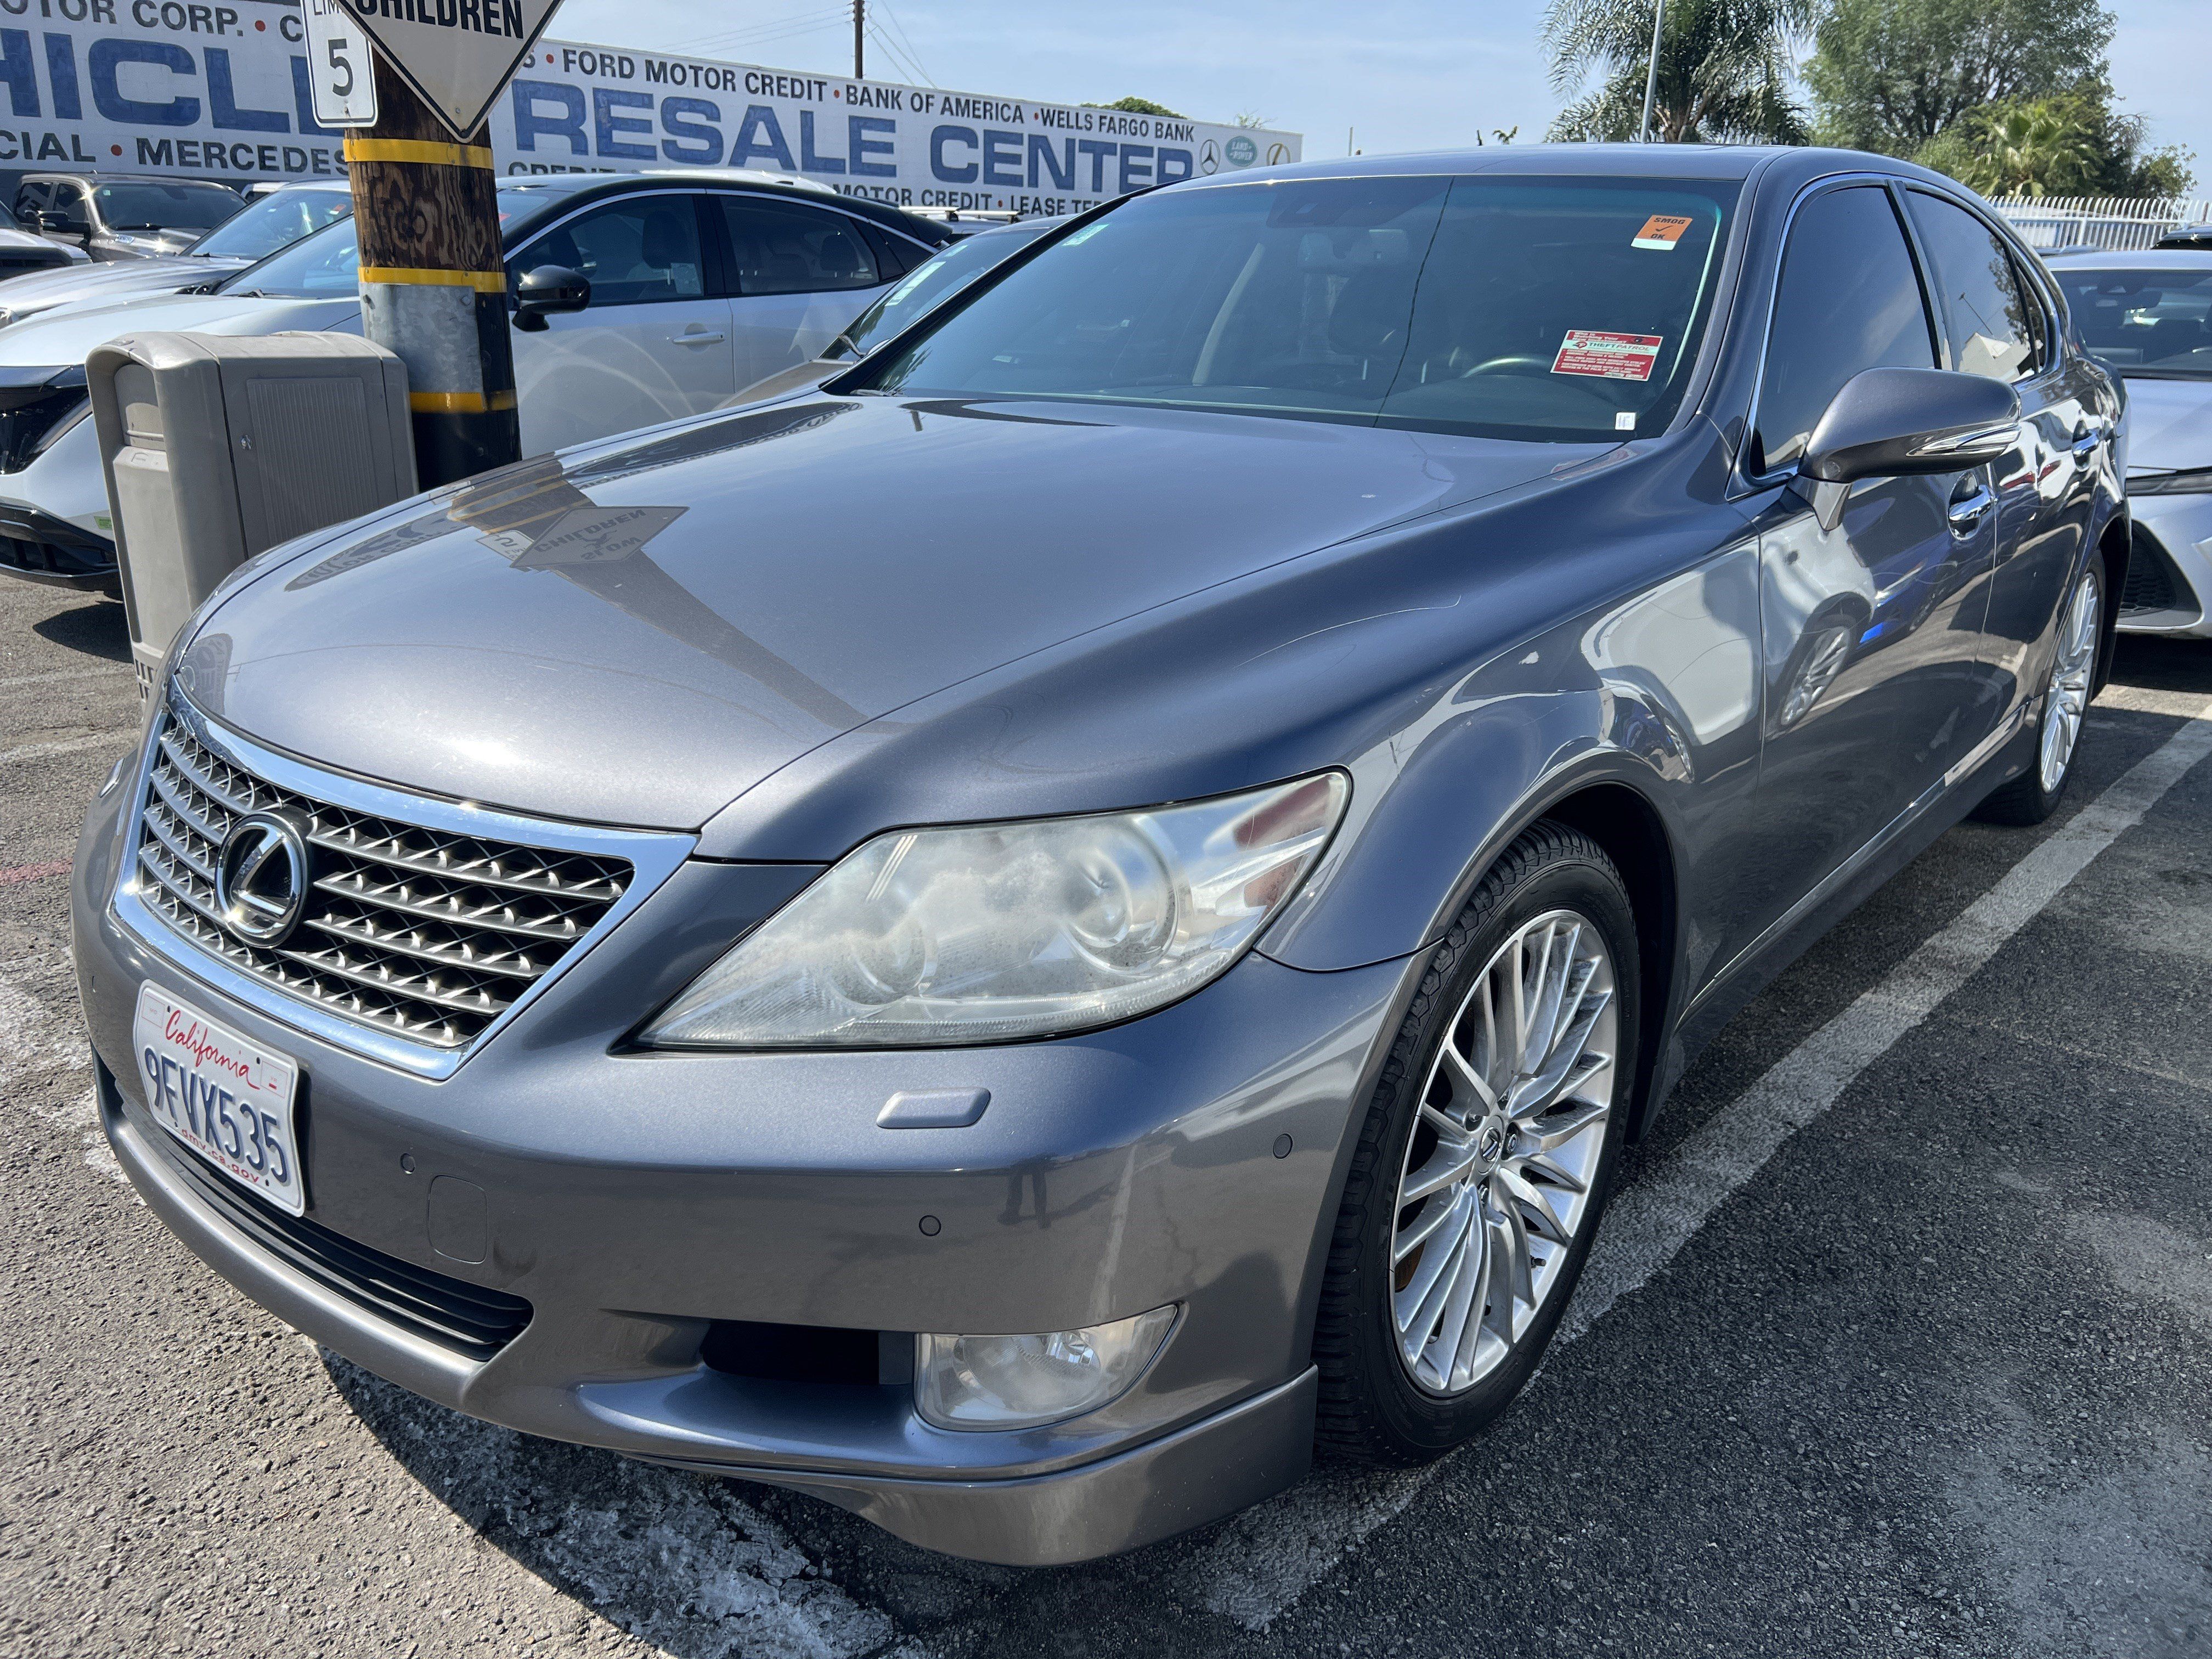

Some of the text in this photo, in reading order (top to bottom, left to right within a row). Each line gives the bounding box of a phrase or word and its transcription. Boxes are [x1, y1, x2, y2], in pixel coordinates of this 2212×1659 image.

[132, 0, 244, 37] CORP.
[313, 0, 339, 15] LIM
[328, 38, 353, 97] 5
[563, 49, 635, 79] FORD
[646, 59, 736, 92] MOTOR
[745, 72, 827, 103] CREDIT
[846, 84, 1024, 125] BANK OF AMERICA
[511, 79, 897, 177] RESALE
[1040, 108, 1195, 143] WELLS FARGO BANK
[136, 137, 349, 175] MERCEDES
[921, 190, 992, 211] CREDIT
[1011, 195, 1103, 216] LEASE TE
[166, 1009, 260, 1090] California
[144, 1047, 289, 1183] 9FVX535
[181, 1128, 259, 1183] dmv.ca.gov
